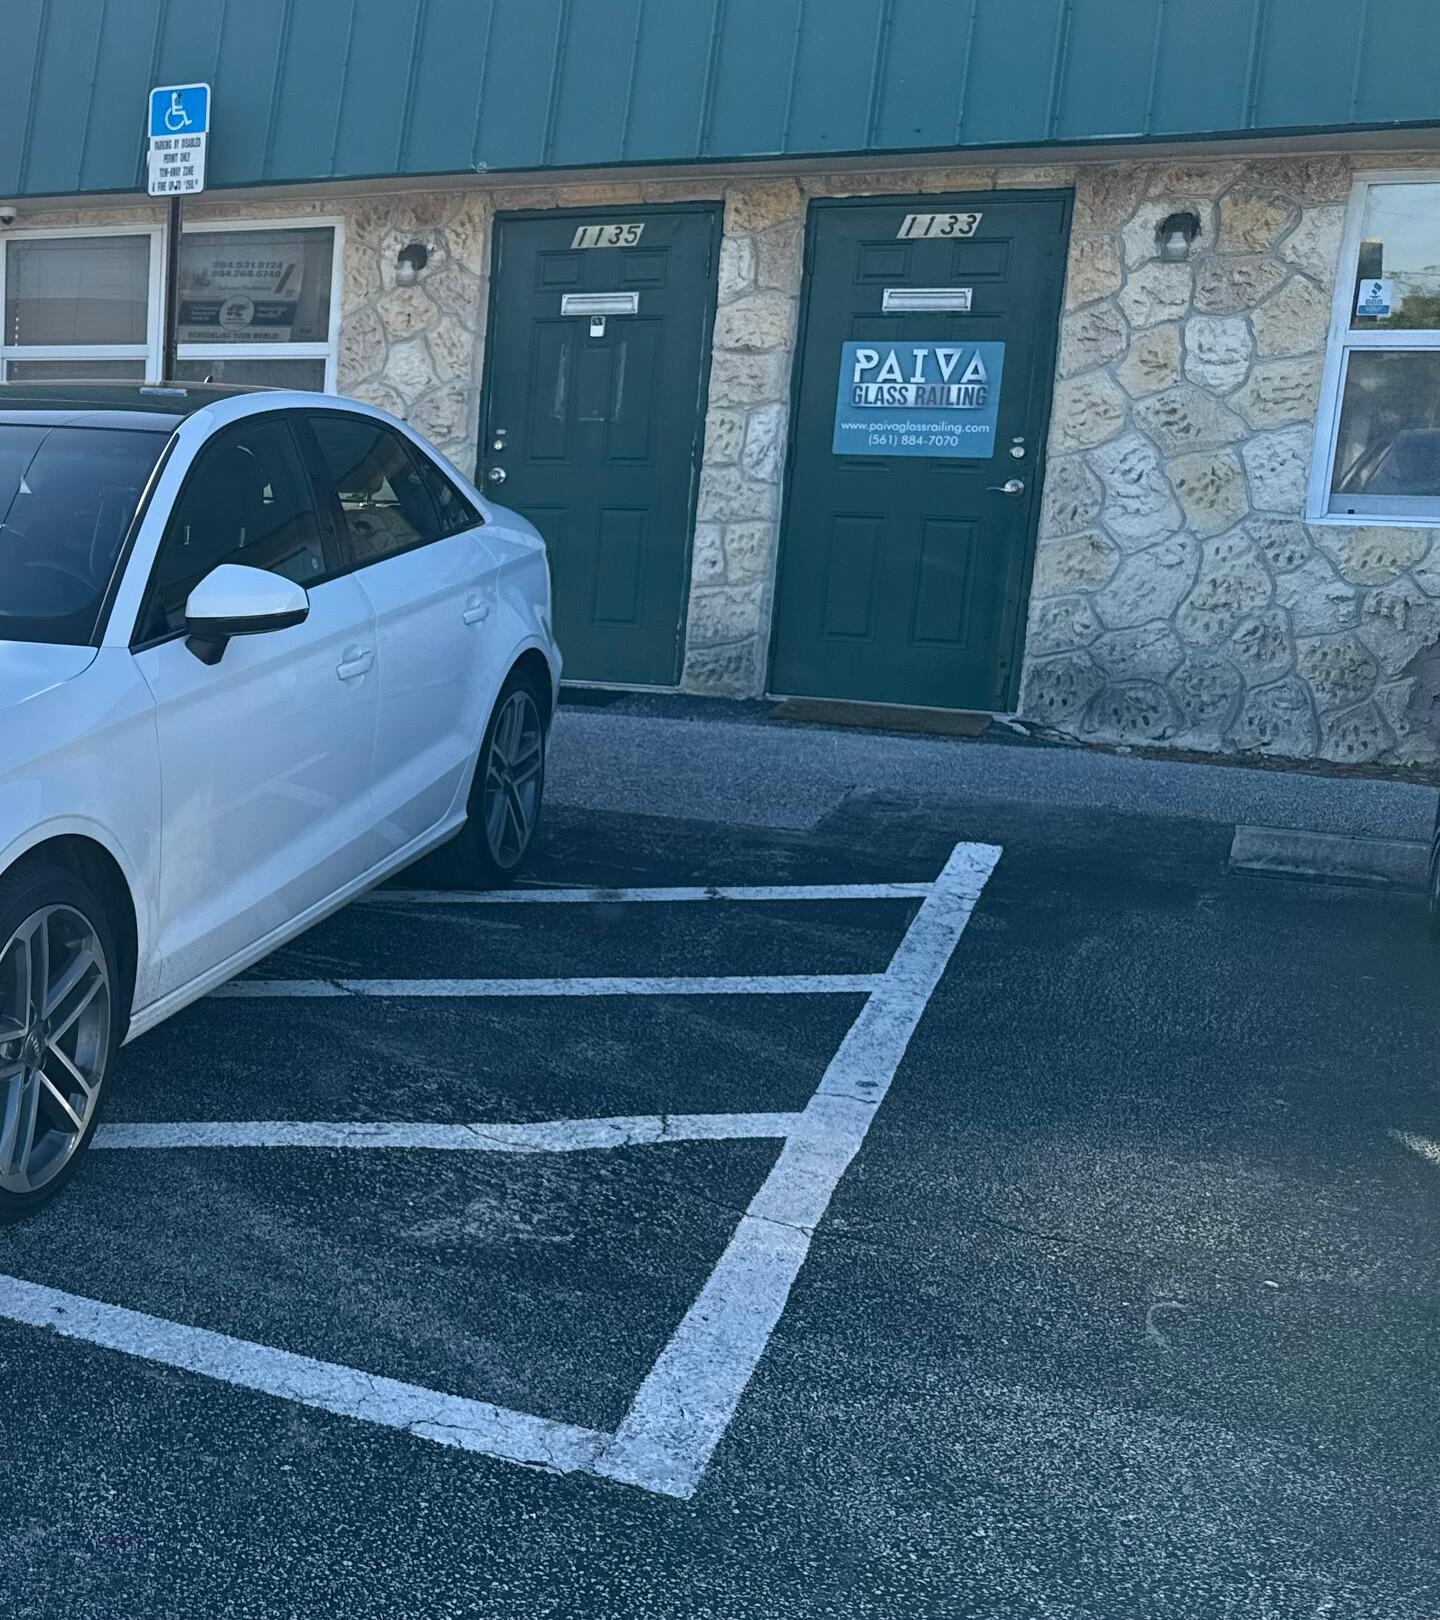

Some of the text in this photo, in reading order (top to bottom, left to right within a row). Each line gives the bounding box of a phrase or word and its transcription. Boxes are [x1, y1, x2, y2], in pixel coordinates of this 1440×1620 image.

[154, 137, 201, 150] PARKING BY DISABLED
[163, 151, 191, 163] PERMIT ONLY
[160, 165, 194, 178] TOW-AWAY ZONE
[157, 181, 167, 191] FINE
[904, 214, 978, 236] 1133
[577, 225, 642, 247] 1135
[853, 348, 989, 383] PAIVA
[852, 385, 989, 406] GLASS RAILING
[841, 420, 990, 435] www.paivaglassrailing.com
[868, 434, 959, 446] (561) 884-7070
